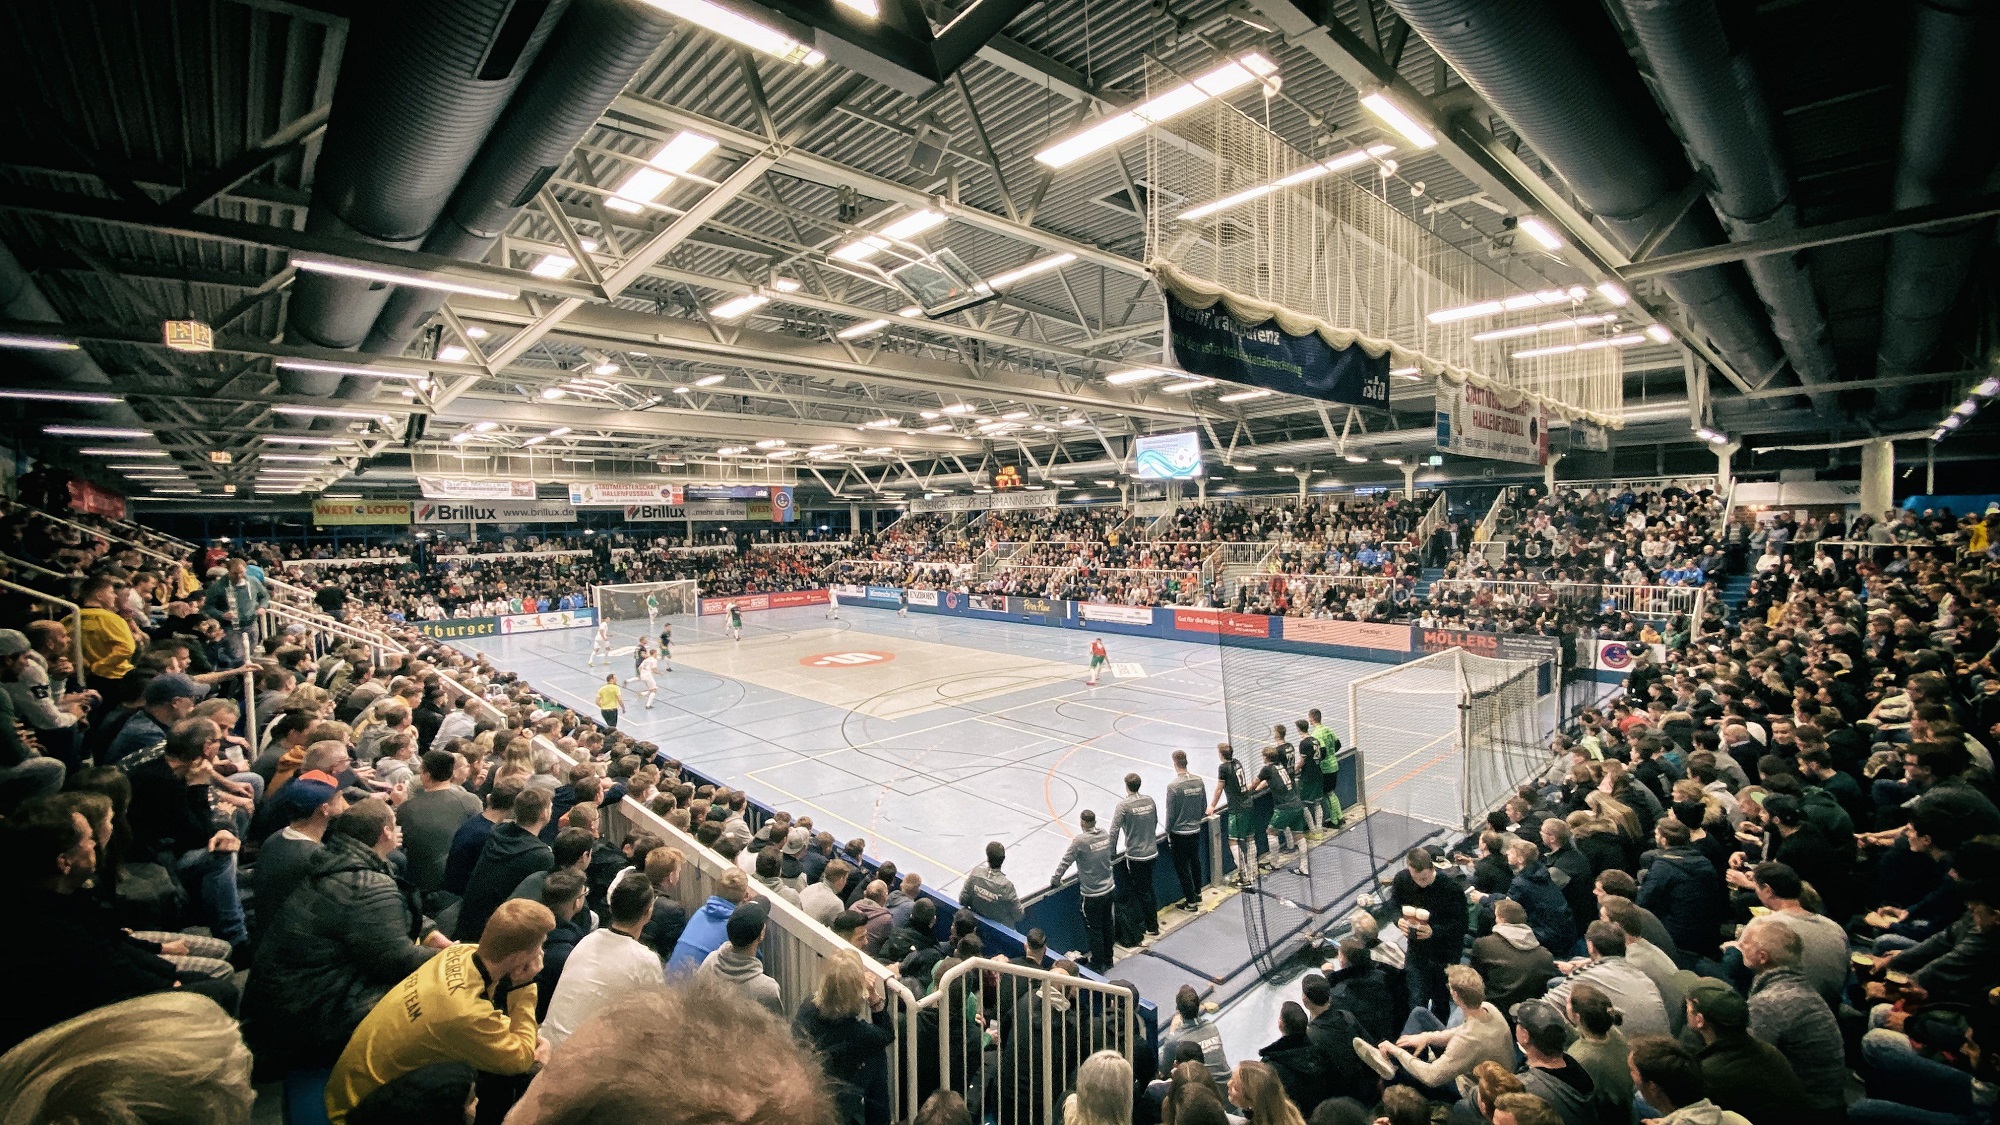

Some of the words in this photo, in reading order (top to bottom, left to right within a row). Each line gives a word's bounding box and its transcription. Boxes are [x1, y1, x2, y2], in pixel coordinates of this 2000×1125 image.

[1362, 375, 1386, 400] ista
[750, 505, 770, 513] WEST
[979, 495, 1022, 508] HERMANN
[316, 505, 354, 515] WEST
[367, 504, 408, 515] LOTTO
[438, 504, 497, 520] Brillux
[502, 507, 575, 517] www.brillux.de
[641, 505, 686, 519] Brillux
[715, 508, 725, 516] als
[726, 507, 746, 516] Farbe
[909, 591, 936, 600] ENZBORN
[423, 622, 494, 638] tburger
[1423, 629, 1498, 649] MÖLLERS
[403, 989, 423, 1023] TEAM
